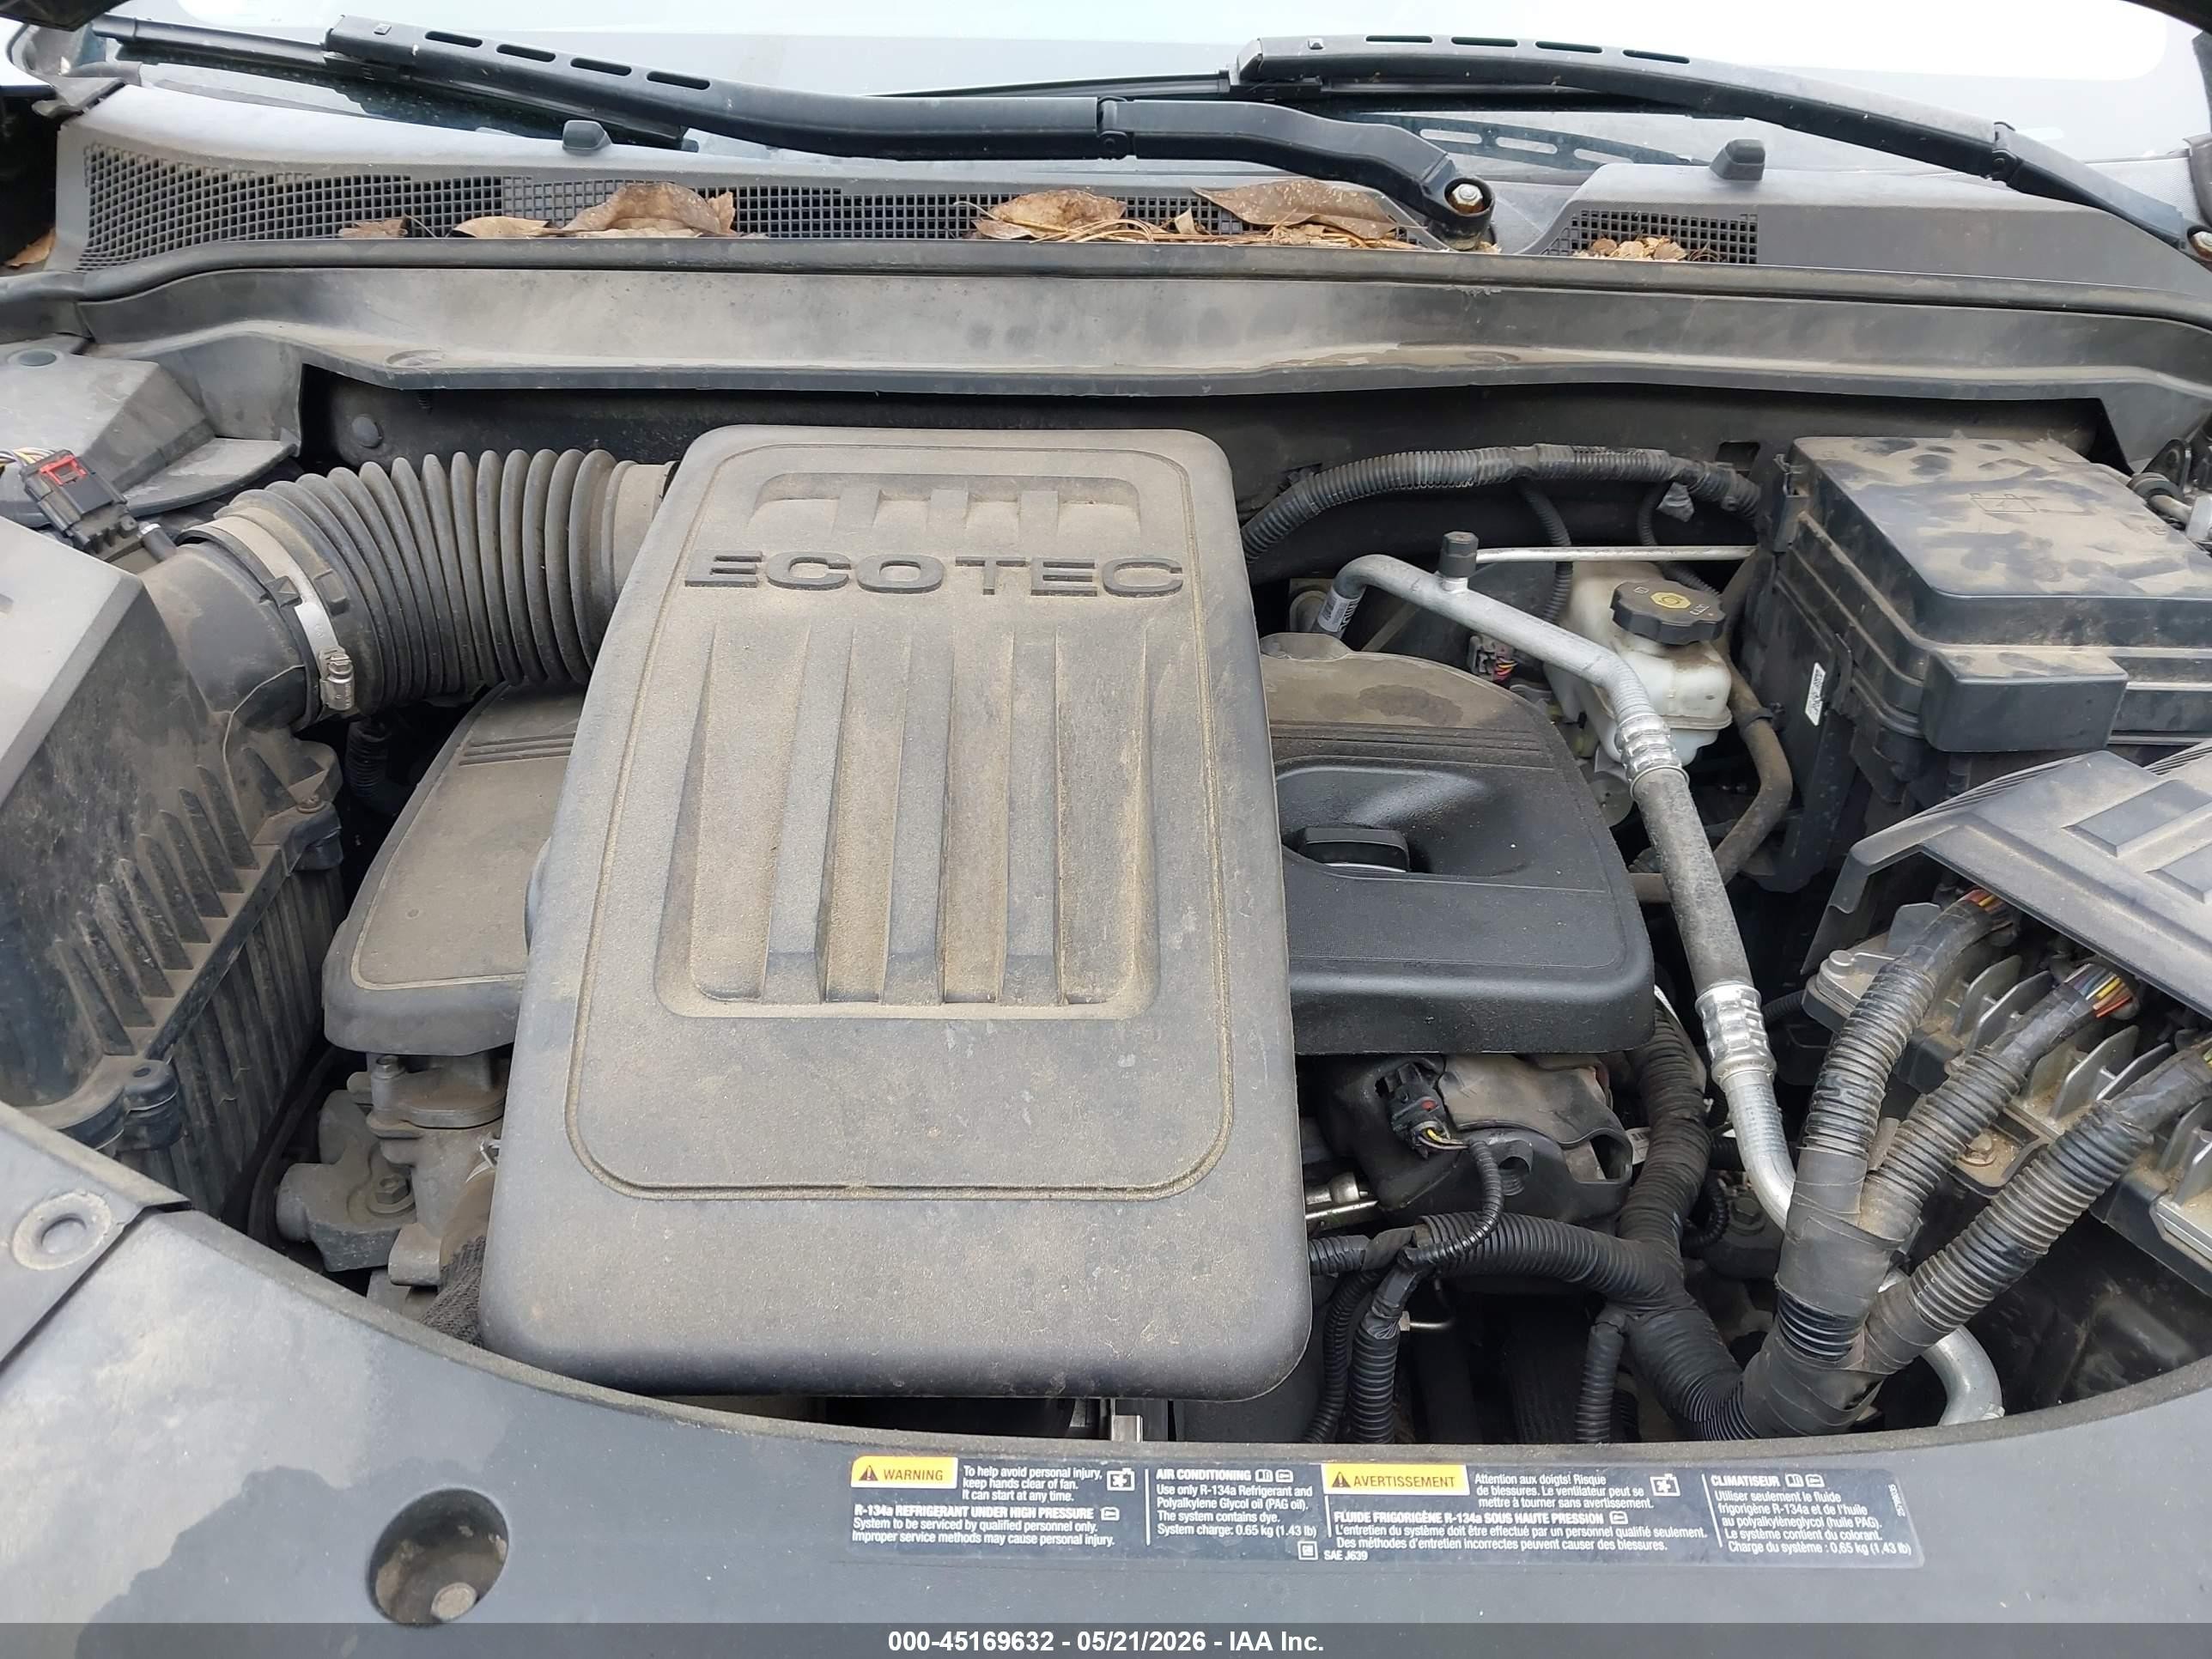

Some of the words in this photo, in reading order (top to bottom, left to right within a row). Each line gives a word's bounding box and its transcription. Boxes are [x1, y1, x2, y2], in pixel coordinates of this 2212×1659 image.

[684, 550, 1184, 598] ECOTEC
[884, 1469, 943, 1480] WARNING
[963, 1465, 975, 1476] To
[977, 1466, 999, 1478] help
[1000, 1468, 1027, 1477] avoid
[1030, 1468, 1070, 1479] personal
[1073, 1468, 1102, 1480] injury,
[1156, 1469, 1175, 1480] AIR
[1176, 1469, 1251, 1480] CONDITIONING
[963, 1480, 987, 1489] keep
[990, 1480, 1019, 1489] hands
[1021, 1480, 1045, 1489] clear
[1048, 1480, 1057, 1489] of
[1060, 1480, 1079, 1489] fan.
[1354, 1475, 1455, 1487] AVERTISSEMENT
[1475, 1474, 1517, 1484] Attention
[1540, 1475, 1571, 1486] doigts!
[1573, 1474, 1606, 1486] Risque
[1711, 1475, 1780, 1487] CLIMATISEUR
[963, 1491, 969, 1499] It
[971, 1492, 989, 1500] can
[992, 1492, 1014, 1500] start
[1029, 1493, 1048, 1503] any
[1049, 1492, 1074, 1501] time.
[1157, 1485, 1175, 1495] Use
[1177, 1485, 1198, 1497] only
[1200, 1486, 1237, 1495] R-134a
[1238, 1486, 1292, 1498] Refrigerant
[1294, 1486, 1313, 1497] and
[1477, 1486, 1488, 1496] de
[1492, 1486, 1540, 1496] blessures.
[1542, 1486, 1553, 1496] Le
[1557, 1486, 1606, 1496] ventilateur
[1608, 1486, 1631, 1498] peut
[1632, 1488, 1644, 1497] se
[1715, 1491, 1747, 1501] Utiliser
[1751, 1492, 1801, 1502] seulement
[1802, 1492, 1812, 1502] le
[1814, 1492, 1841, 1503] fluide
[1157, 1498, 1217, 1510] Polyalkylene
[1219, 1498, 1249, 1510] Glycol
[1251, 1499, 1263, 1509] oil
[1266, 1499, 1288, 1510] (PAG
[1291, 1499, 1308, 1510] oil).
[1479, 1498, 1510, 1508] mettre
[1513, 1498, 1519, 1508] à
[1522, 1498, 1556, 1508] tourner
[1559, 1499, 1581, 1508] sans
[1583, 1498, 1654, 1509] avertissement.
[854, 1504, 893, 1516] R-134a
[896, 1505, 969, 1517] REFRIGERANT
[971, 1506, 1007, 1518] UNDER
[1010, 1508, 1036, 1518] HIGH
[1038, 1508, 1094, 1519] PRESSURE
[1718, 1504, 1771, 1516] frigorigène
[1772, 1504, 1808, 1515] R-134a
[1812, 1505, 1821, 1515] et
[1823, 1505, 1836, 1515] de
[1838, 1504, 1868, 1515] l'huile
[1158, 1510, 1176, 1521] The
[1178, 1512, 1213, 1522] system
[1216, 1512, 1257, 1522] contains
[1260, 1512, 1279, 1523] dye.
[1334, 1511, 1370, 1522] FLUIDE
[1373, 1510, 1443, 1523] FRIGORIGÈNE
[1445, 1512, 1482, 1523] R-134a
[1484, 1513, 1513, 1523] SOUS
[1516, 1513, 1549, 1524] HAUTE
[1552, 1513, 1603, 1524] PRESSION
[1826, 1517, 1853, 1528] (huile
[1855, 1517, 1882, 1528] PAG).
[854, 1517, 890, 1530] System
[893, 1519, 903, 1528] to
[906, 1519, 918, 1528] be
[921, 1520, 963, 1529] serviced
[964, 1521, 976, 1532] by
[980, 1521, 1021, 1531] qualified
[1024, 1522, 1073, 1533] personnel
[1075, 1522, 1097, 1533] only.
[1158, 1524, 1194, 1536] System
[1197, 1525, 1233, 1537] charge:
[1236, 1525, 1259, 1535] 0.65
[1261, 1526, 1273, 1537] kg
[1276, 1526, 1301, 1537] (1.43
[1304, 1527, 1317, 1538] lb)
[1335, 1525, 1386, 1535] L'entretien
[1389, 1526, 1402, 1535] du
[1404, 1525, 1445, 1538] système
[1448, 1526, 1466, 1535] doit
[1468, 1525, 1487, 1536] être
[1490, 1526, 1529, 1536] effectué
[1532, 1528, 1547, 1538] par
[1566, 1528, 1613, 1538] personnel
[1616, 1527, 1651, 1538] qualifié
[1653, 1528, 1707, 1537] seulement.
[1725, 1529, 1738, 1539] Le
[1741, 1528, 1781, 1541] système
[1784, 1529, 1823, 1540] contient
[1825, 1530, 1838, 1540] du
[1840, 1530, 1882, 1540] colorant.
[853, 1531, 897, 1543] Improper
[900, 1532, 935, 1542] service
[939, 1533, 981, 1543] methods
[984, 1534, 1006, 1546] may
[1008, 1535, 1037, 1544] cause
[1040, 1534, 1082, 1546] personal
[1085, 1534, 1115, 1547] injury.
[1337, 1538, 1356, 1548] Des
[1359, 1538, 1407, 1548] méthodes
[1409, 1538, 1462, 1548] d'entretien
[1464, 1540, 1518, 1549] incorrectes
[1521, 1540, 1559, 1551] peuvent
[1562, 1540, 1594, 1550] causer
[1597, 1540, 1615, 1550] des
[1618, 1540, 1668, 1550] blessures.
[1729, 1541, 1763, 1554] Charge
[1766, 1542, 1779, 1553] du
[1782, 1542, 1823, 1555] système
[1855, 1543, 1869, 1555] kg
[1899, 1544, 1911, 1555] lb)
[1324, 1551, 1342, 1560] SAE
[1345, 1551, 1368, 1560] J639
